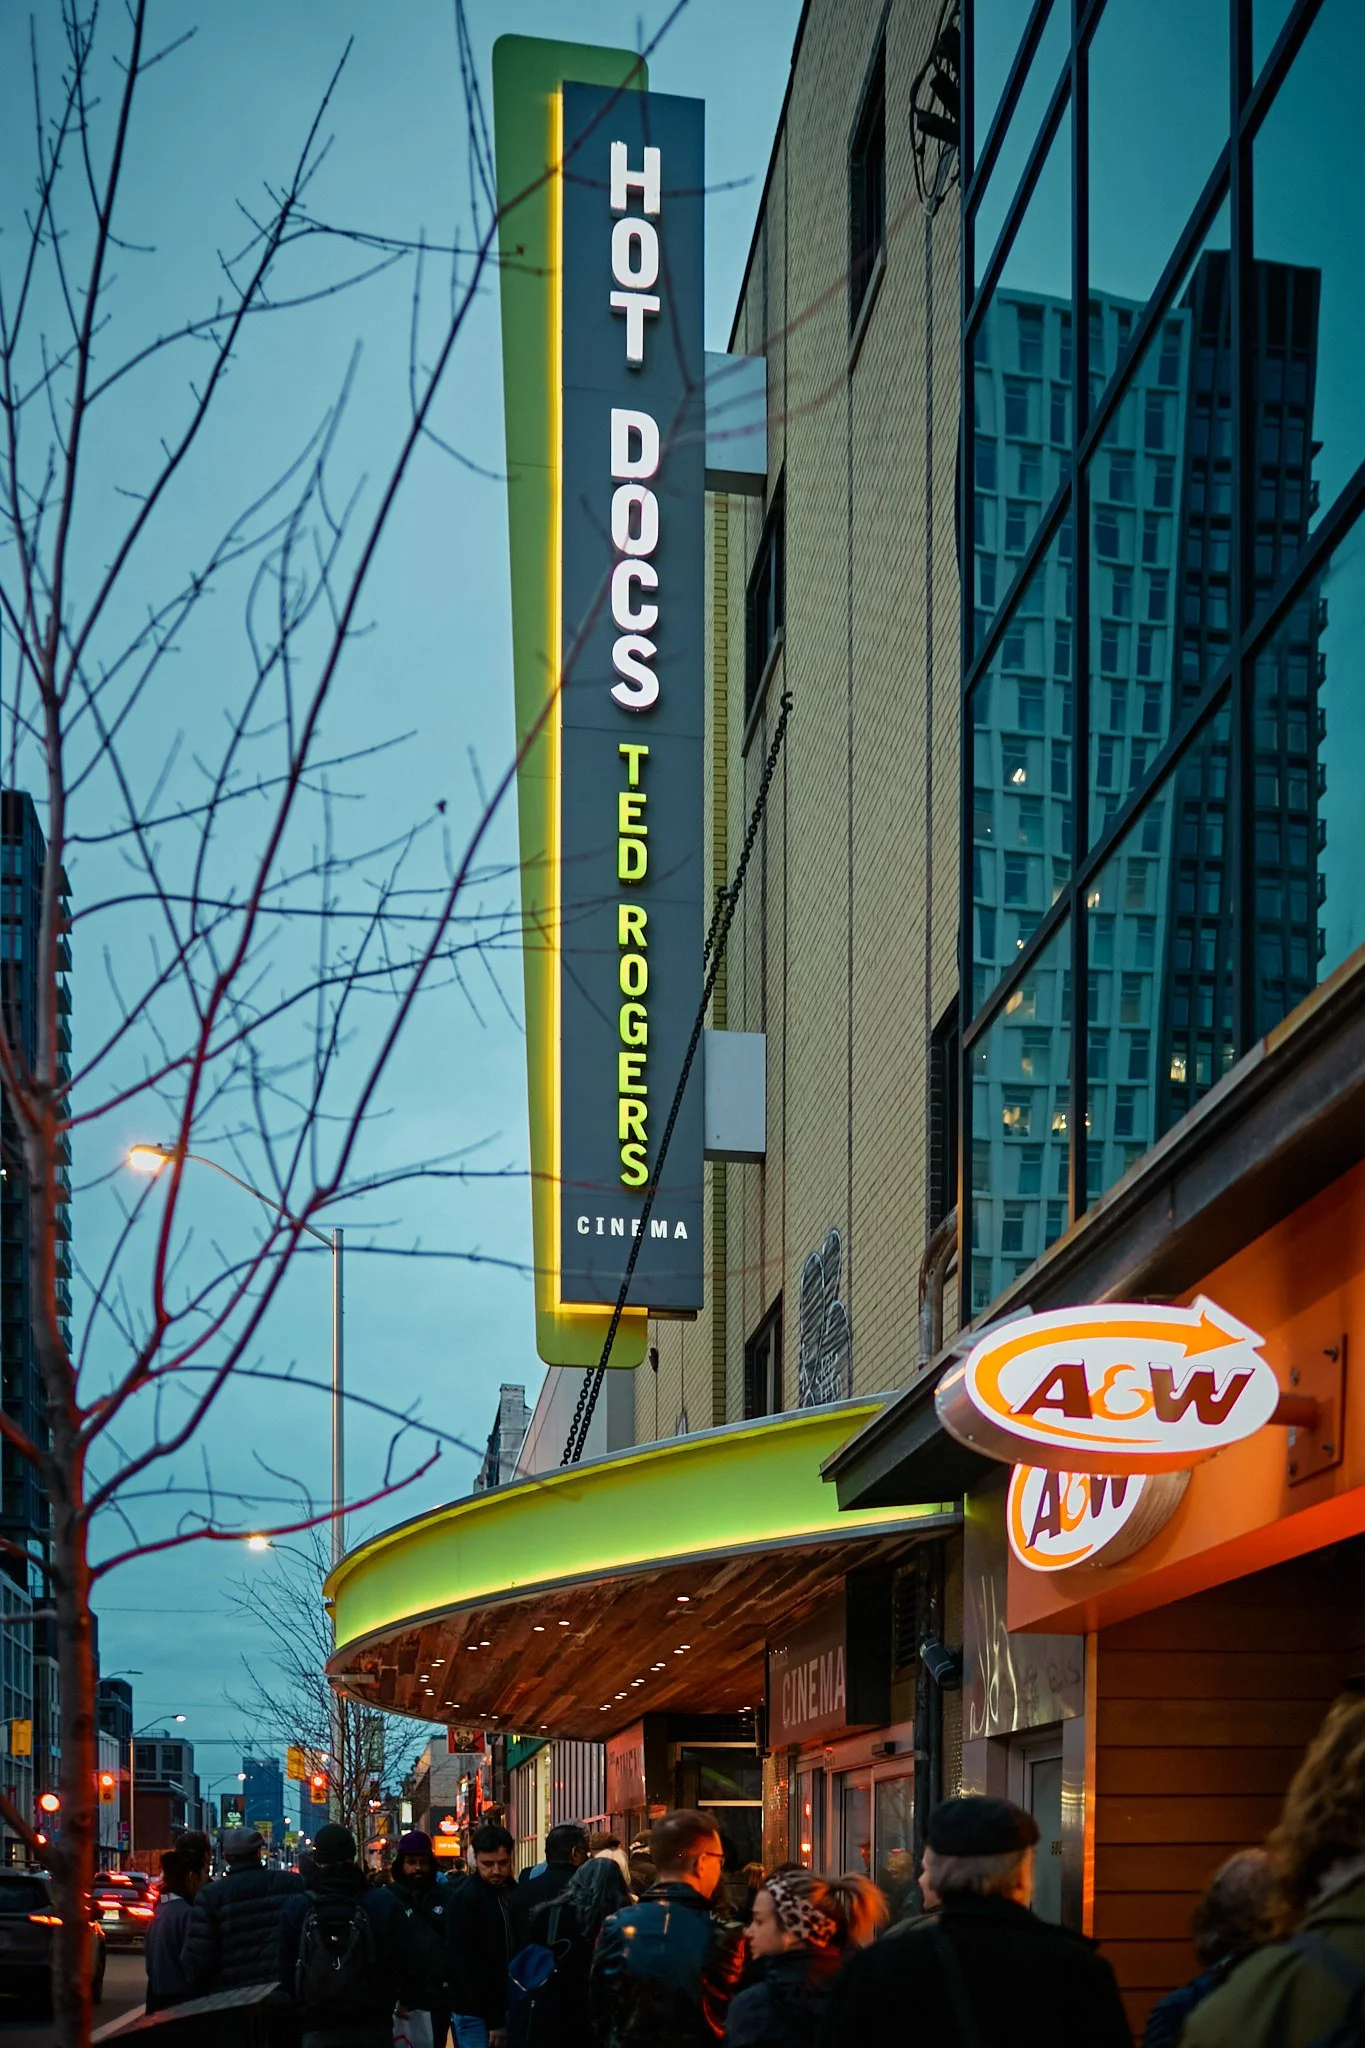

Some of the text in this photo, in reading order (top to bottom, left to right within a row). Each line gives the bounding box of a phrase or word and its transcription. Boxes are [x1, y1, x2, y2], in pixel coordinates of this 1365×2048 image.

[609, 140, 661, 712] HOT DOCS
[617, 743, 649, 1188] TED ROGERS
[577, 1215, 688, 1240] CINEMA
[1009, 1357, 1256, 1426] A&W
[1025, 1469, 1129, 1549] A&W
[782, 1645, 846, 1729] CINEMA
